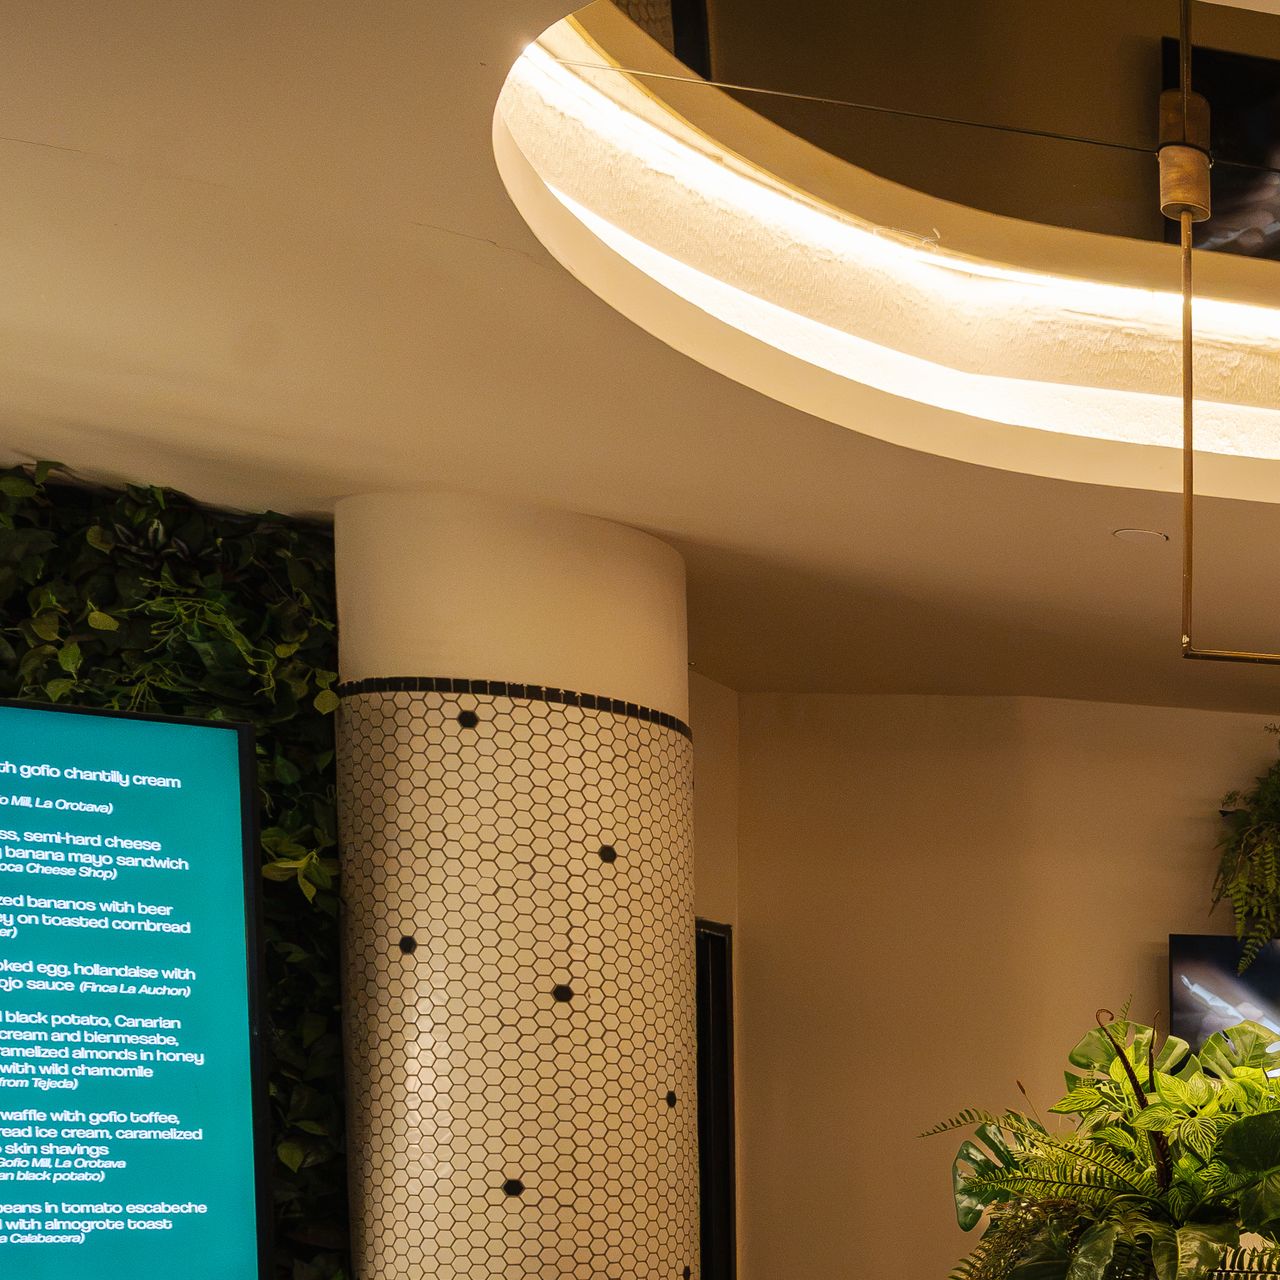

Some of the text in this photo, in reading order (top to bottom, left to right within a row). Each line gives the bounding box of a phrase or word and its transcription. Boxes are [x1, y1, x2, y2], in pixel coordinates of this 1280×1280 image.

[20, 764, 61, 778] gofio
[64, 767, 130, 787] chantilly
[133, 775, 181, 788] cream
[11, 796, 32, 808] Mill,
[35, 797, 53, 808] La
[55, 799, 113, 814] Orotava)
[24, 832, 101, 846] semi-hard
[104, 836, 161, 851] cheese
[5, 846, 65, 861] banana
[68, 853, 113, 867] mayo
[116, 856, 189, 870] sandwich
[26, 863, 76, 876] Cheese
[79, 866, 117, 880] Shop)
[27, 895, 96, 911] bananos
[99, 901, 135, 913] with
[138, 902, 173, 915] beer
[17, 914, 39, 924] on
[42, 914, 109, 928] toasted
[37, 964, 71, 977] egg,
[74, 963, 158, 978] hollandaise
[161, 968, 196, 980] with
[27, 980, 75, 991] sauce
[80, 981, 118, 993] (Finca
[119, 984, 136, 994] La
[138, 985, 191, 997] Auchon)
[5, 1011, 48, 1024] black
[51, 1014, 112, 1027] potato,
[114, 1015, 181, 1029] Canarian
[0, 1030, 179, 1046] cream and bienmesabe,
[0, 1046, 204, 1065] amelized almonds in honey
[0, 1062, 153, 1077] with wild chamomile
[32, 1078, 78, 1090] Tejeda)
[0, 1109, 180, 1125] waffle with gofio toffee,
[35, 1126, 58, 1138] ice
[61, 1129, 112, 1139] cream,
[115, 1128, 202, 1140] caramelized
[5, 1143, 37, 1154] skin
[40, 1143, 109, 1158] shavings
[31, 1158, 52, 1168] Mill,
[55, 1158, 72, 1168] La
[74, 1158, 126, 1168] Orotava
[16, 1171, 51, 1180] black
[53, 1171, 105, 1183] potato)
[45, 1202, 58, 1213] in
[62, 1202, 123, 1213] tomato
[126, 1202, 207, 1213] escabeche
[5, 1219, 42, 1230] with
[45, 1218, 124, 1233] almogrote
[127, 1219, 172, 1230] toast
[10, 1233, 85, 1244] Calabacera)
